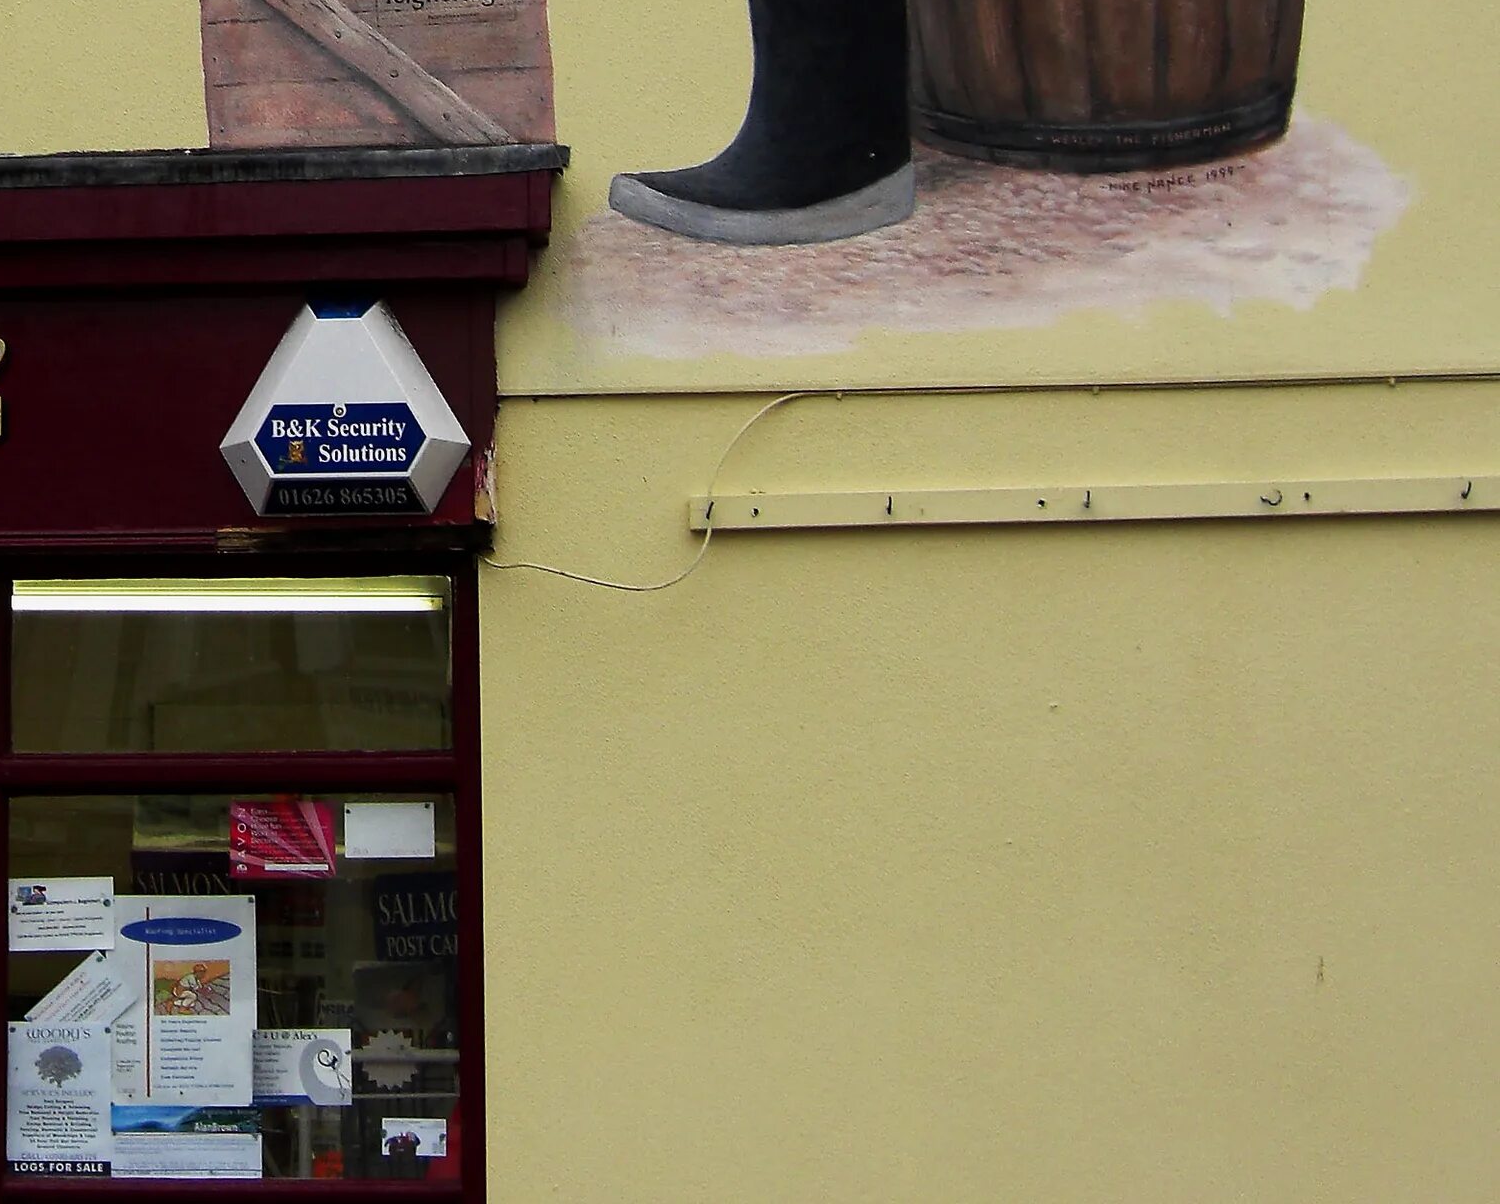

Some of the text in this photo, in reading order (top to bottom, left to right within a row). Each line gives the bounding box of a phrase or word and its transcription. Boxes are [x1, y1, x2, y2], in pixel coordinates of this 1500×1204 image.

[271, 417, 407, 440] B&K Security
[318, 444, 407, 464] Solutions
[279, 487, 407, 506] 01626 865305
[388, 936, 424, 956] POST
[14, 1163, 104, 1172] LOGS FOR SALE
